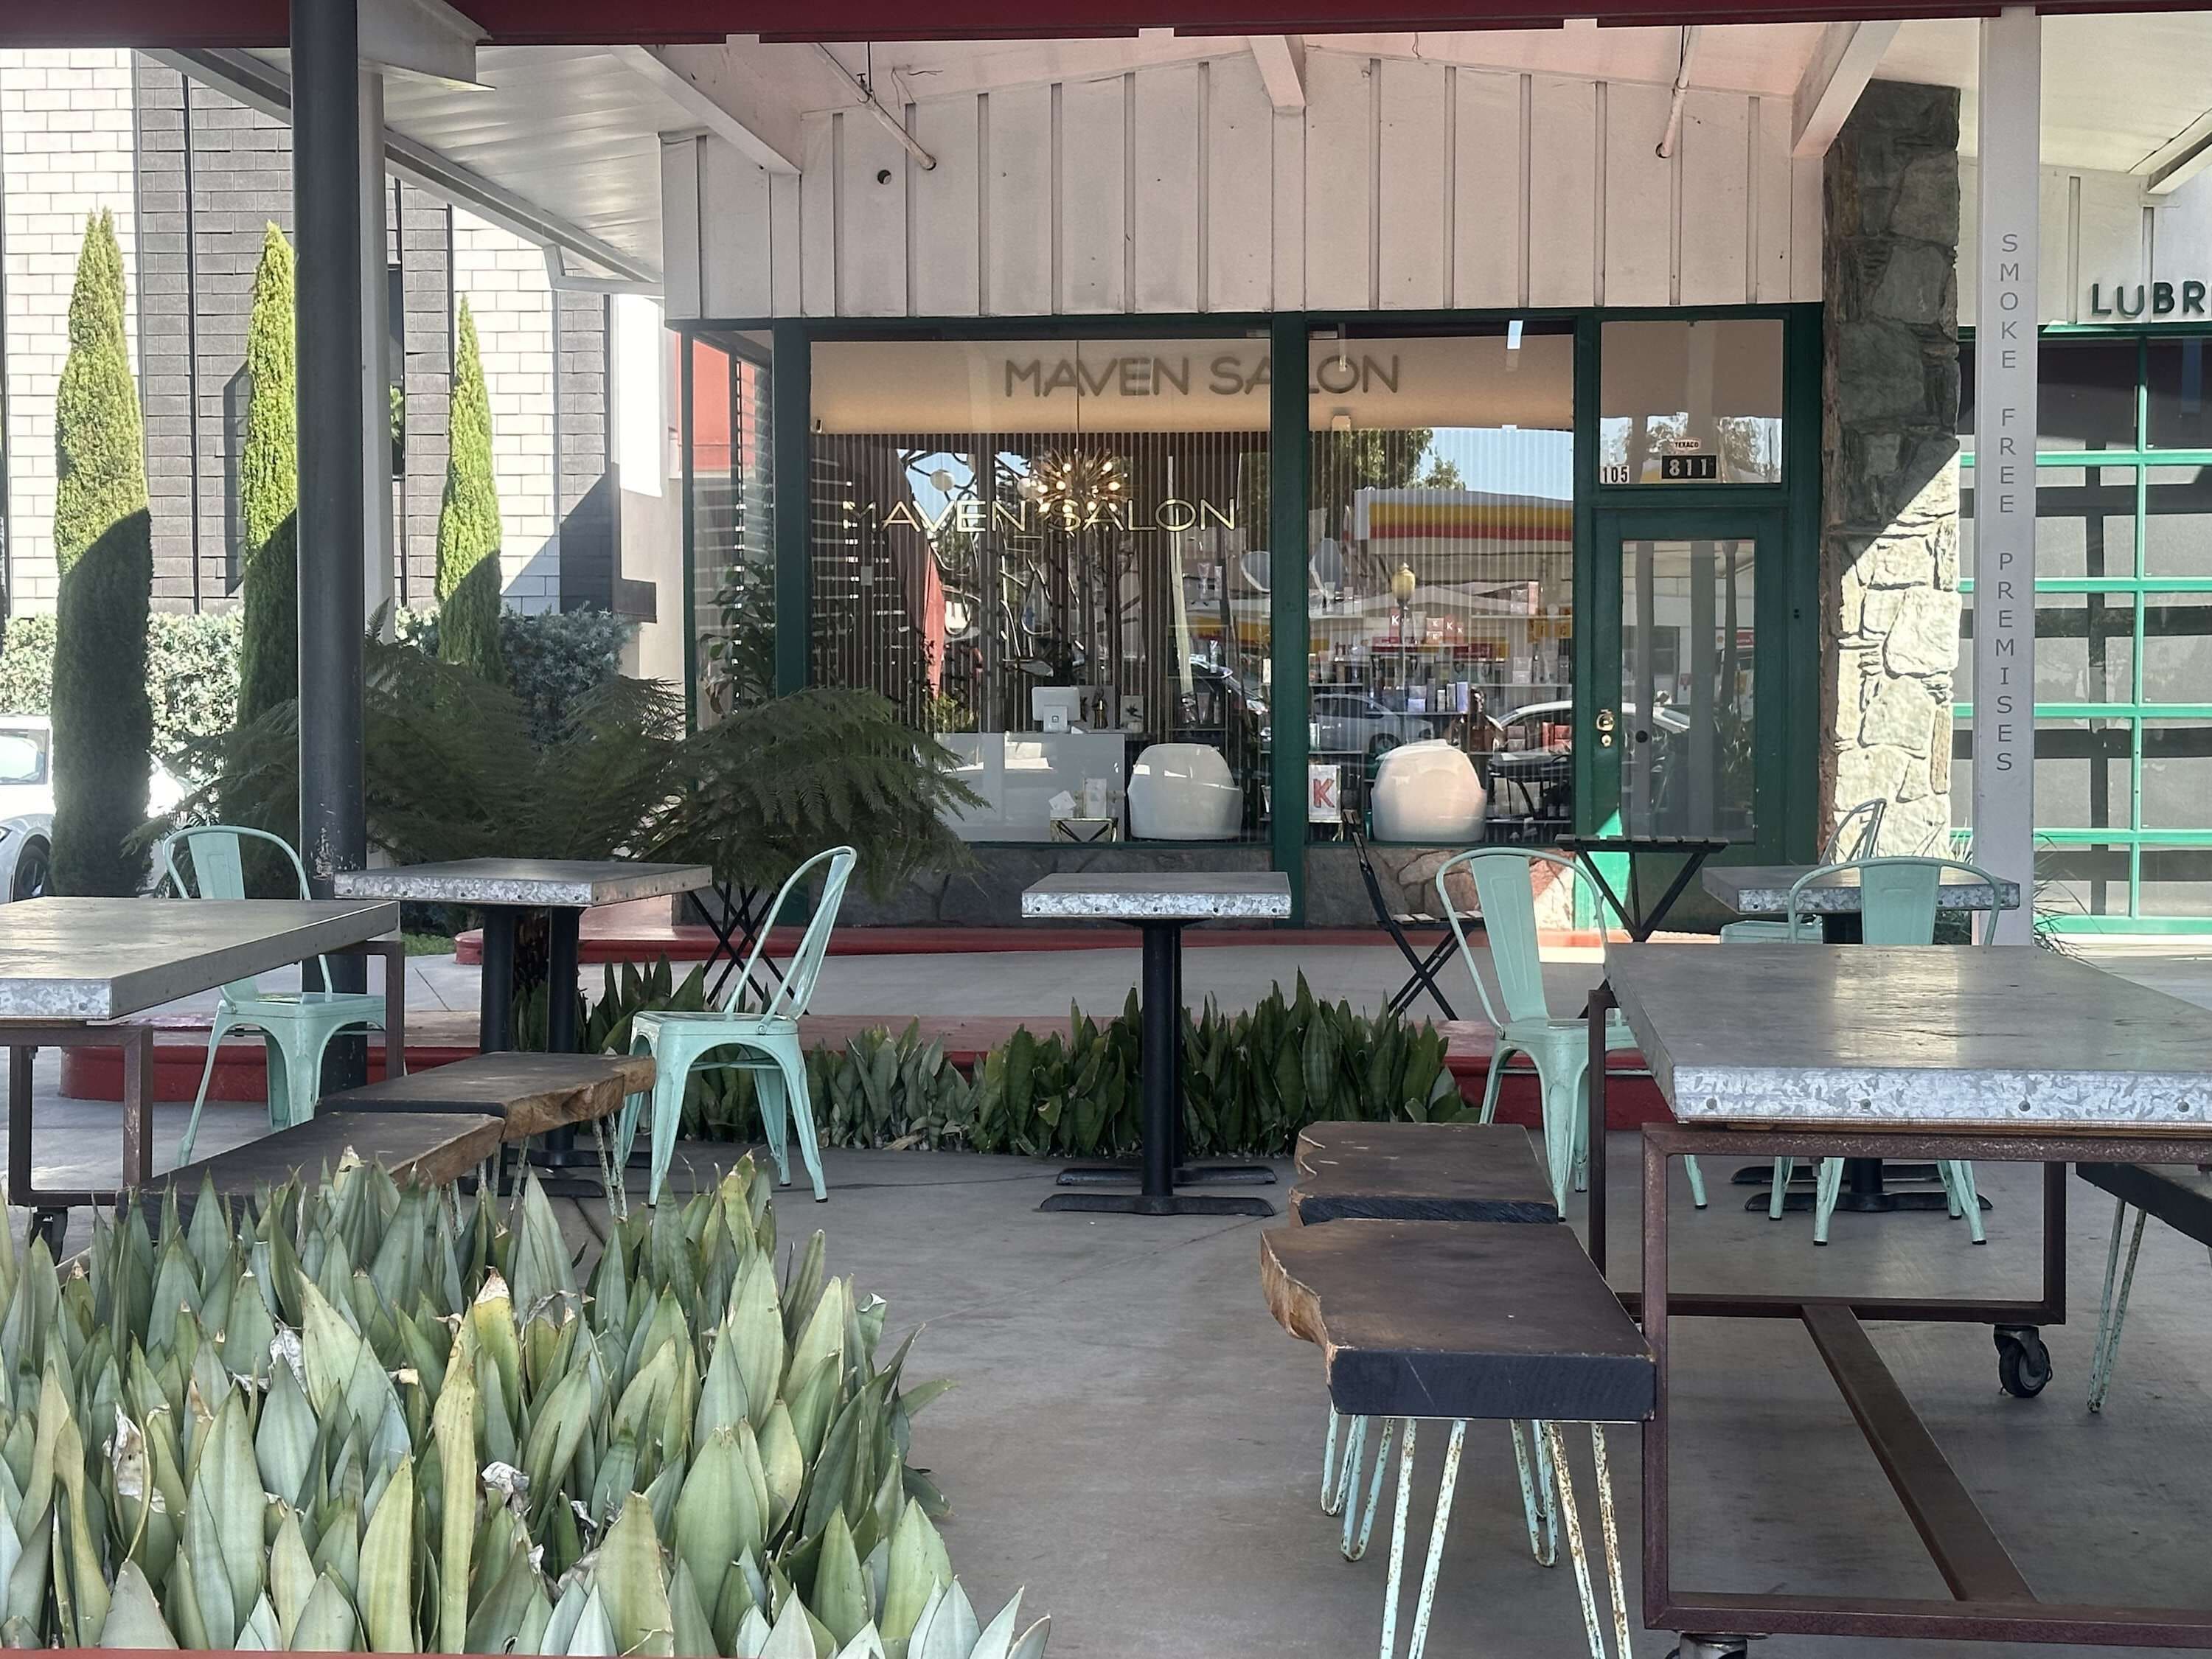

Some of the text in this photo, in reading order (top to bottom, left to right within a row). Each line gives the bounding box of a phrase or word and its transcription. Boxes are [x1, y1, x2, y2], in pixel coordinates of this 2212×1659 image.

[2091, 279, 2212, 317] LUBR
[1005, 355, 1399, 397] MAVEN SAON
[1603, 466, 1628, 484] 105
[1669, 459, 1708, 477] 811
[842, 498, 1236, 533] MAVEN SALON
[1995, 233, 2019, 771] SMOKE FREE PREMISES
[1312, 778, 1335, 809] K
